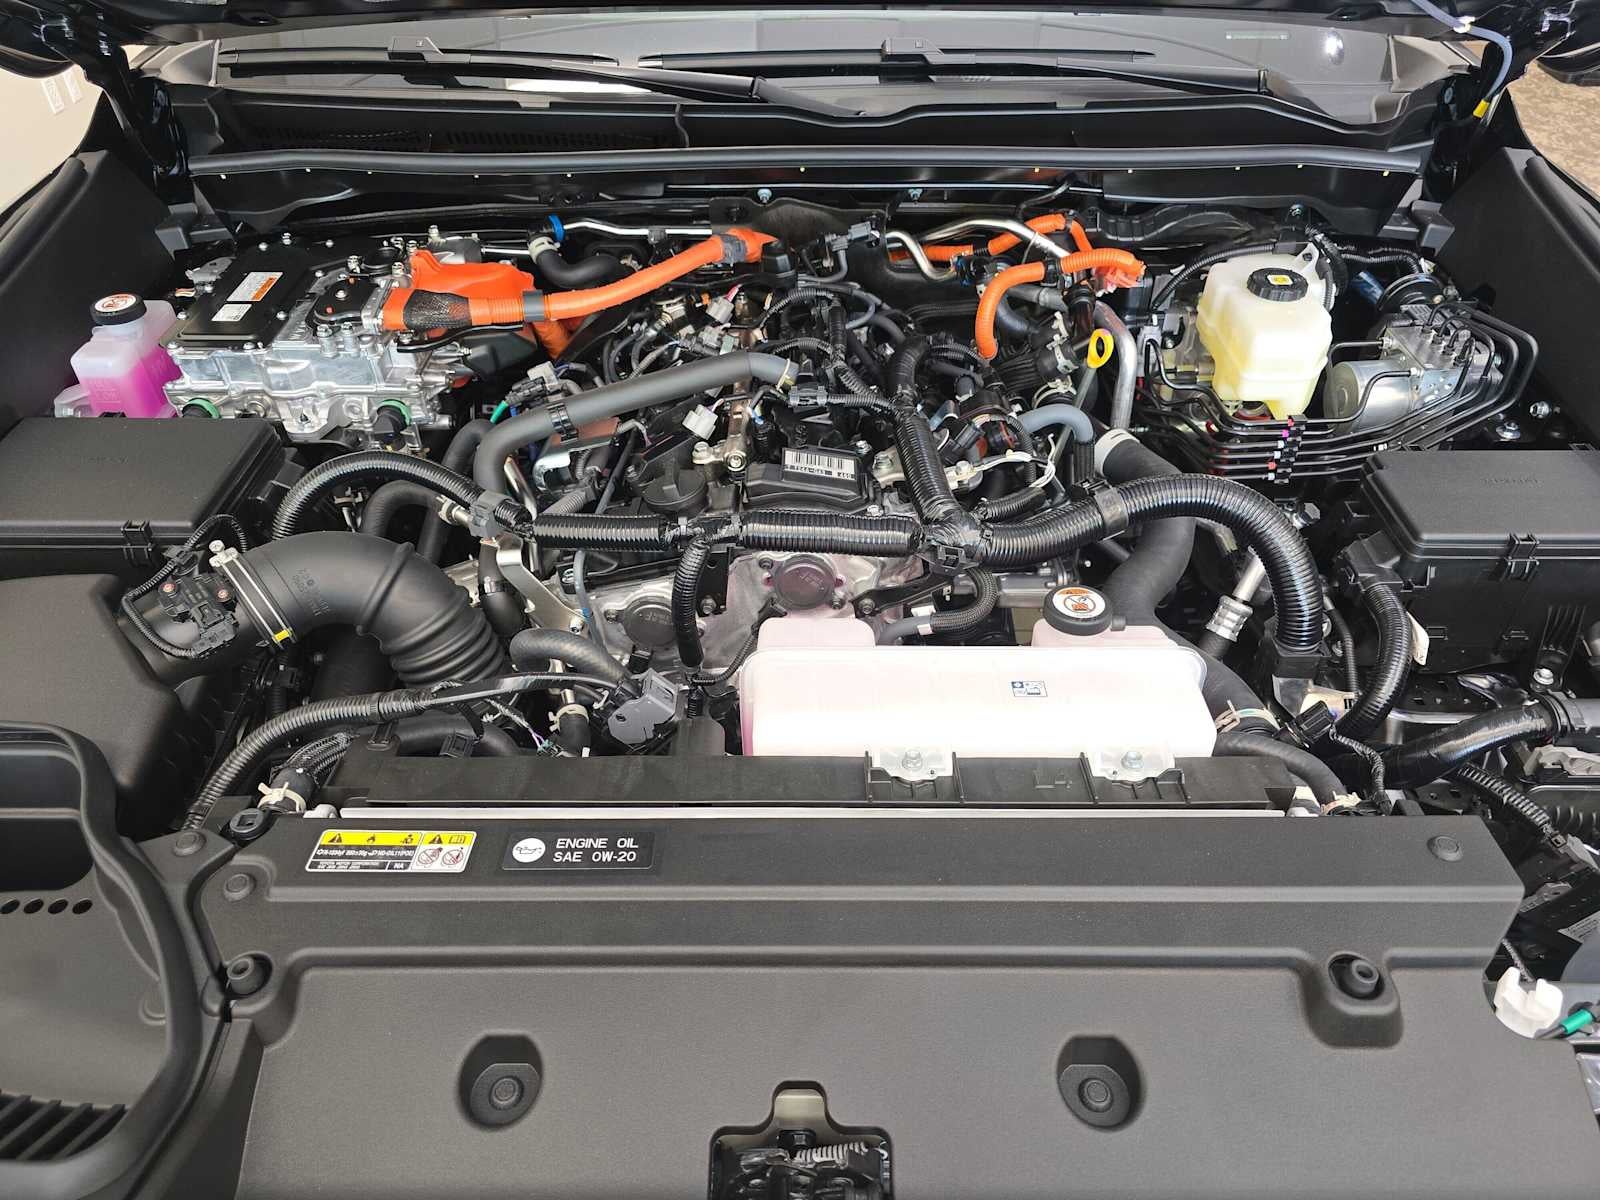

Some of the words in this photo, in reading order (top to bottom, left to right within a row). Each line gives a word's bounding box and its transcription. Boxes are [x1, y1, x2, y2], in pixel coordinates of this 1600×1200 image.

[556, 838, 608, 849] ENGINE
[616, 838, 639, 849] OIL
[553, 851, 583, 862] SAE
[591, 851, 637, 862] 0W-20
